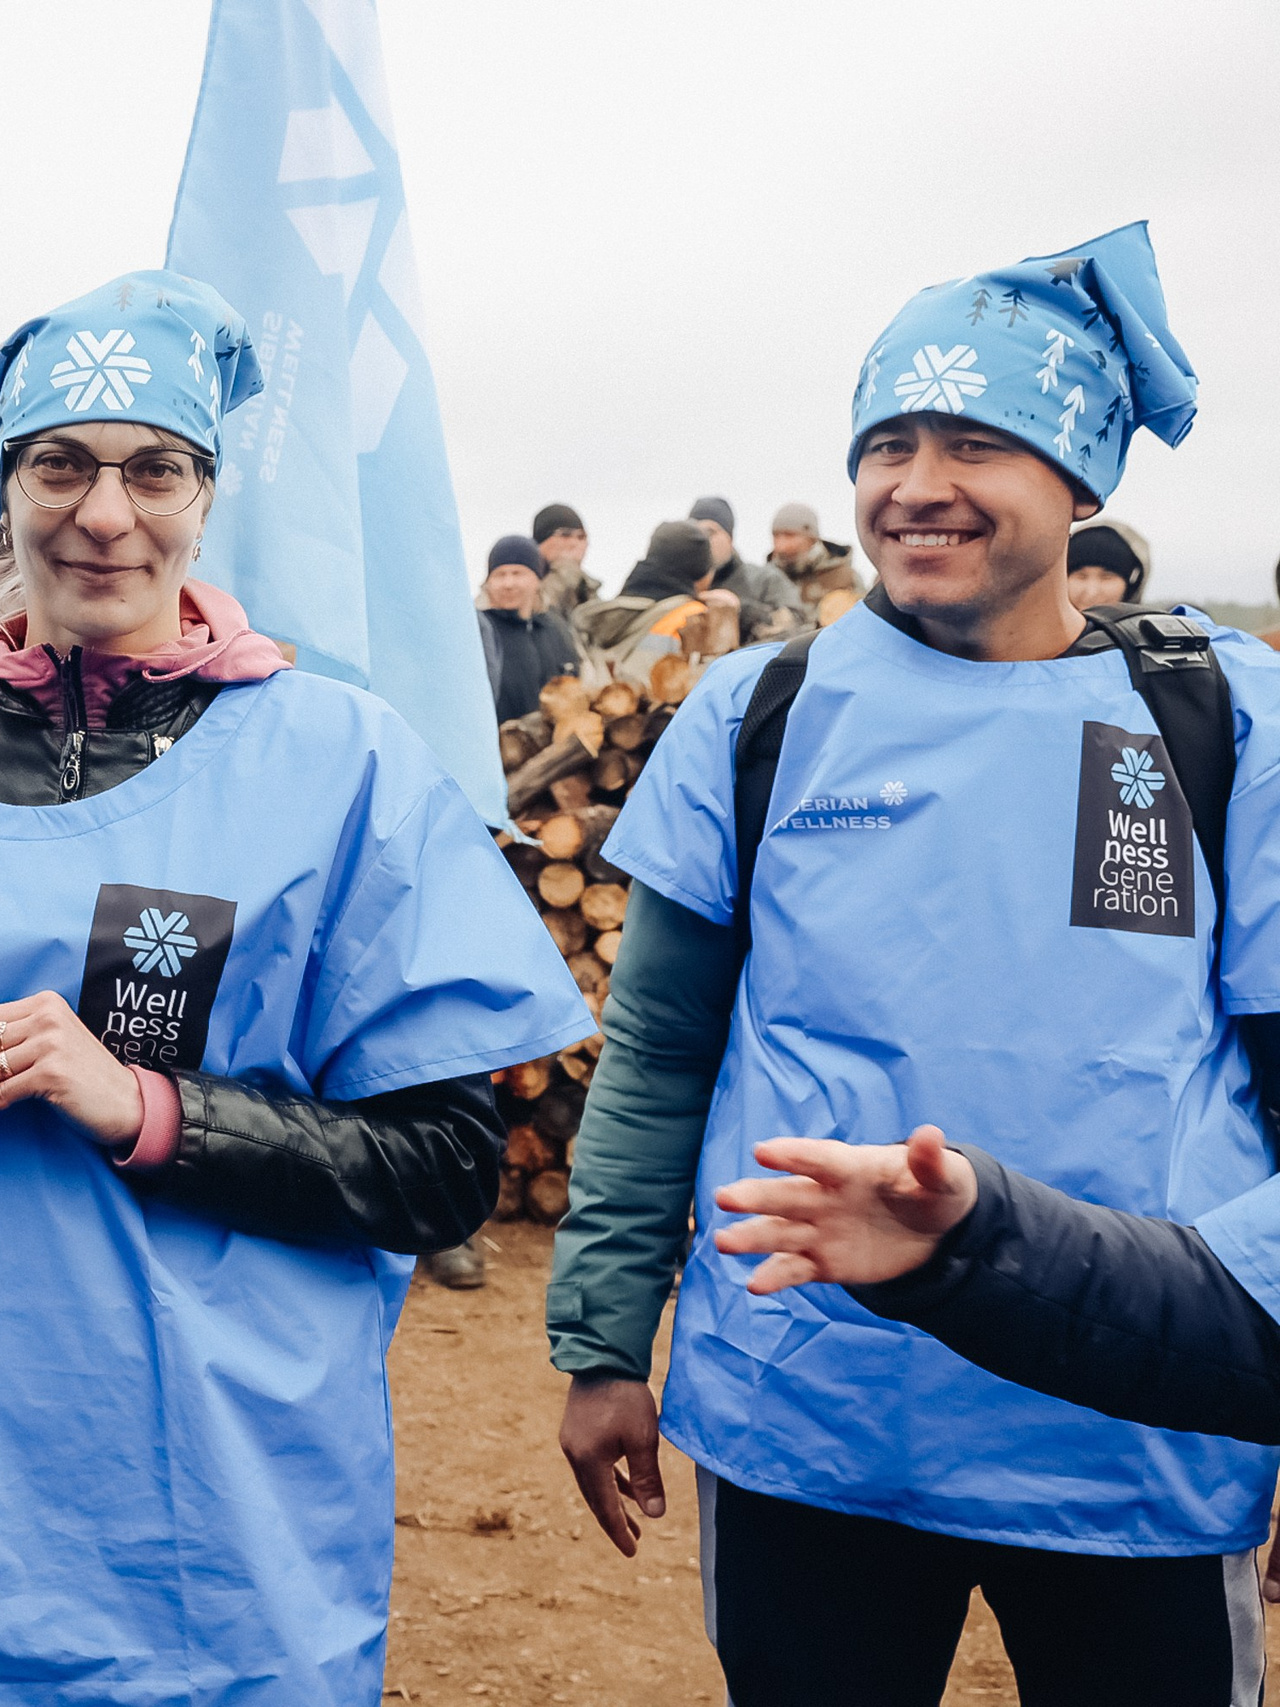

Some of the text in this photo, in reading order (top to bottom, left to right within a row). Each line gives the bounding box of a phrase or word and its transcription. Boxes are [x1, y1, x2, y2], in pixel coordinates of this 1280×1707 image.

[1108, 809, 1168, 845] Well
[1104, 839, 1169, 869] ness
[1099, 858, 1174, 893] Gene
[1093, 888, 1178, 917] ration
[116, 978, 188, 1018] Well
[107, 1011, 181, 1041] ness
